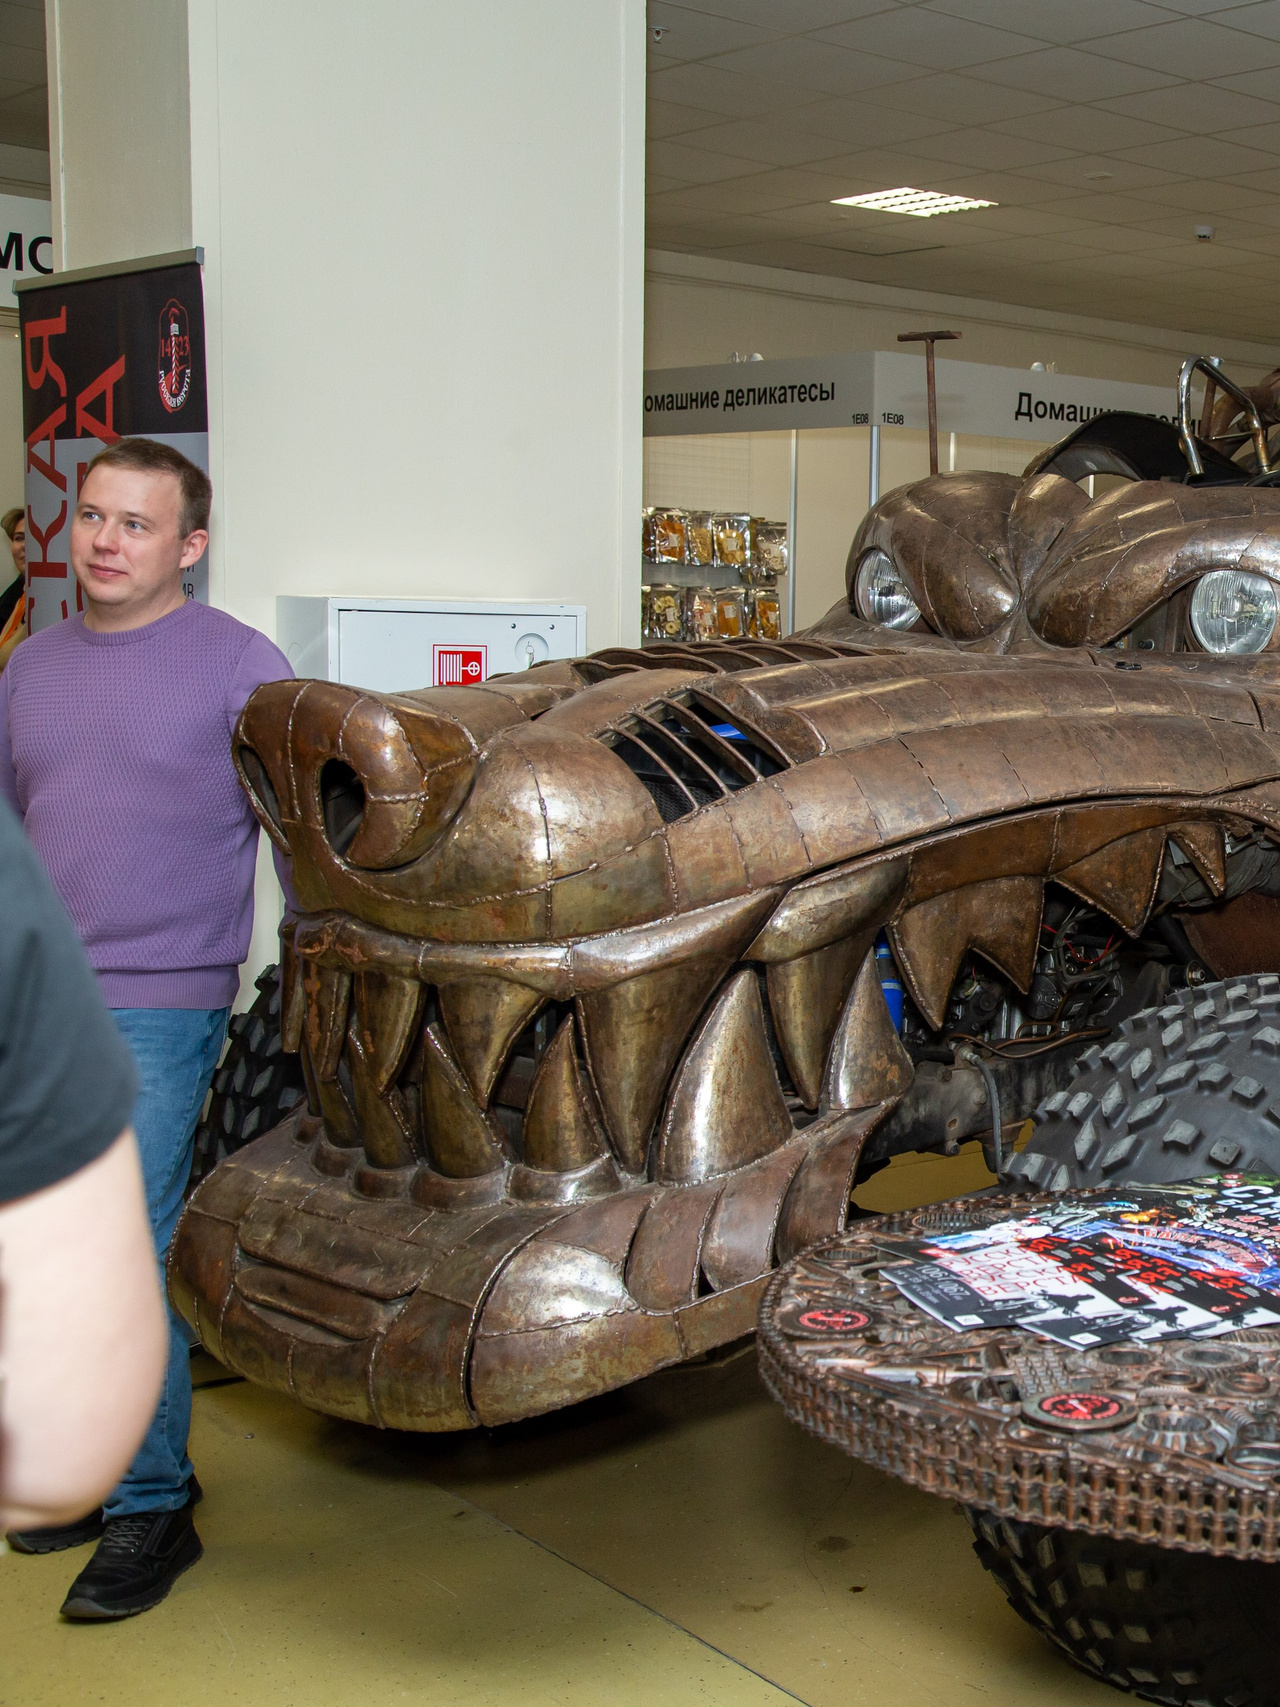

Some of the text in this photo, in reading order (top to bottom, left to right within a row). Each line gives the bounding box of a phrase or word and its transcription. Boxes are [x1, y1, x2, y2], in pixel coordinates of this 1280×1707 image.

[644, 382, 835, 412] омашние деликатесы
[851, 413, 869, 425] 1E08
[882, 412, 904, 425] 1E08
